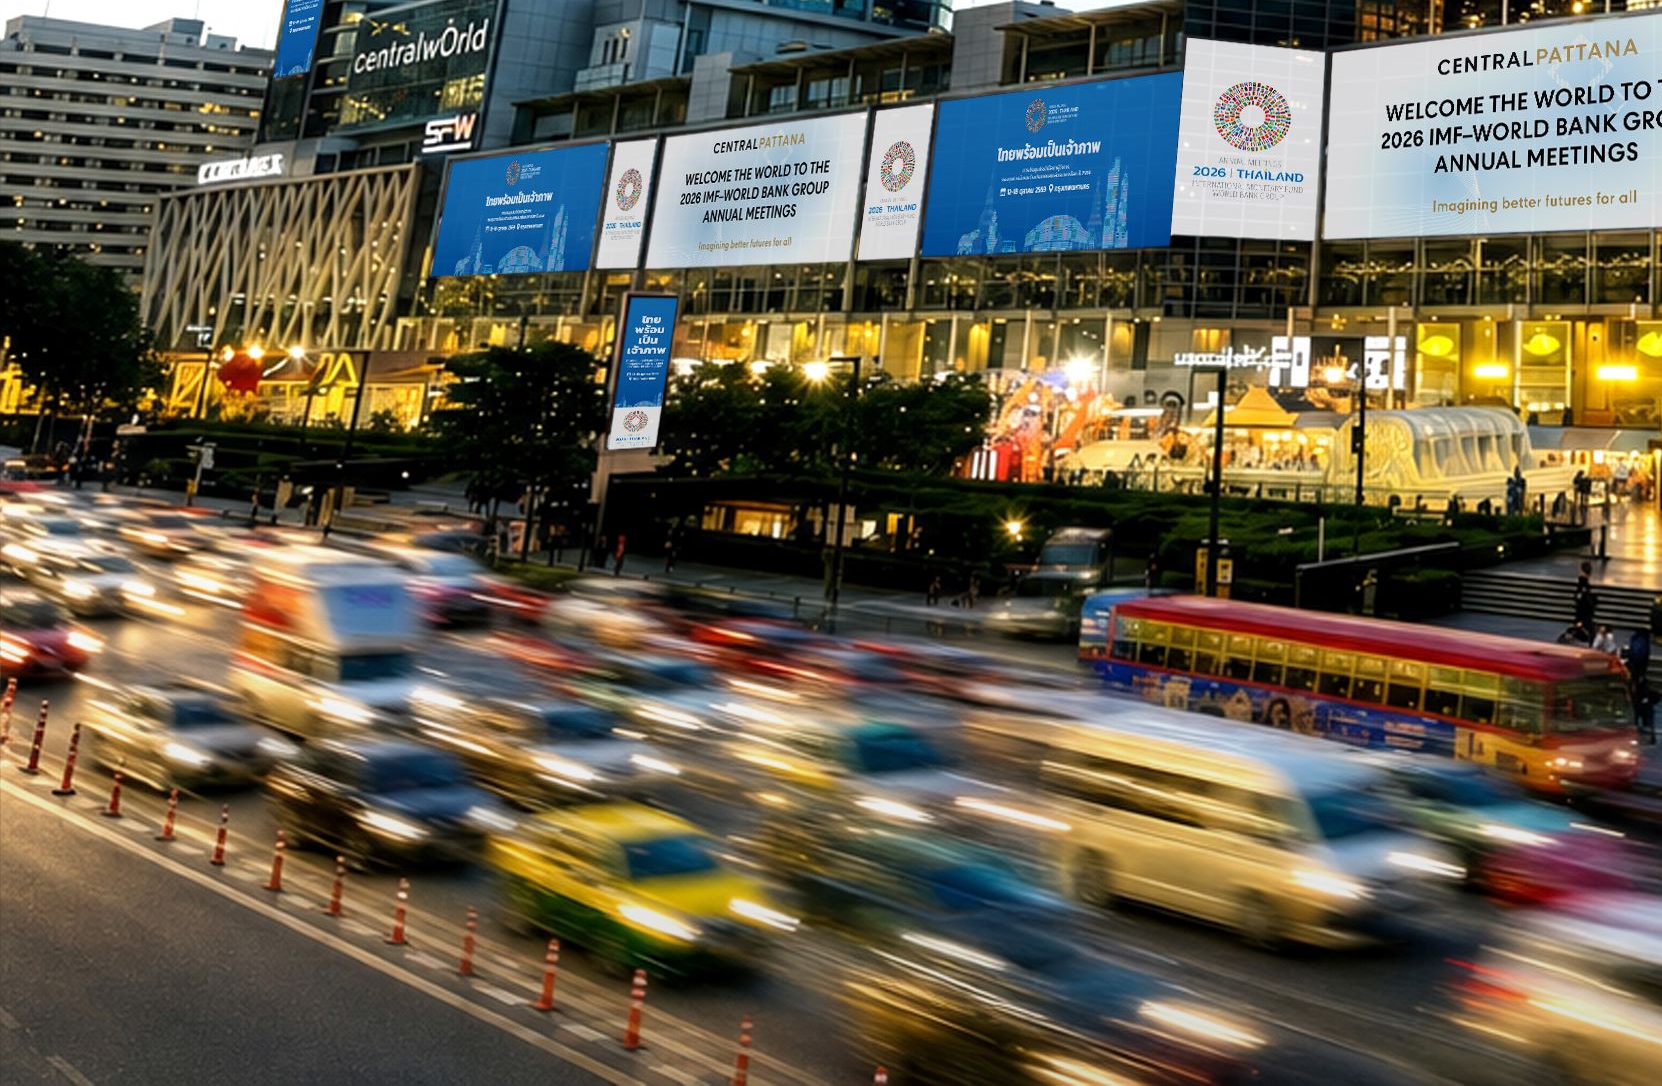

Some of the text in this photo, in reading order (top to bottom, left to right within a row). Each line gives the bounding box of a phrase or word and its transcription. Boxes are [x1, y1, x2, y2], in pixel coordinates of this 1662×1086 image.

[1385, 95, 1484, 122] WELCOME
[1489, 91, 1528, 112] THE
[1534, 84, 1615, 110] WORLD
[1620, 80, 1652, 101] TO
[1381, 129, 1424, 150] 2026
[1556, 112, 1618, 137] BANK
[997, 139, 1101, 162] ไทยพร้อมเป็นเจ้าภาพ
[1433, 141, 1639, 174] ANNUAL MEETINGS
[685, 160, 830, 186] WELCOME THE WORLD TO THE
[1193, 166, 1226, 177] 2026
[680, 192, 701, 205] 2026
[761, 183, 790, 199] BANK
[791, 181, 829, 196] GROUP
[1432, 189, 1638, 215] Imagining better futures for all
[703, 204, 797, 223] ANNUAL MEETINGS
[698, 241, 729, 252] Imagining
[730, 240, 749, 249] better
[773, 238, 782, 247] for
[635, 325, 665, 334] พร้อม
[642, 315, 662, 324] ไทย
[627, 345, 667, 355] เจ้าภาพ
